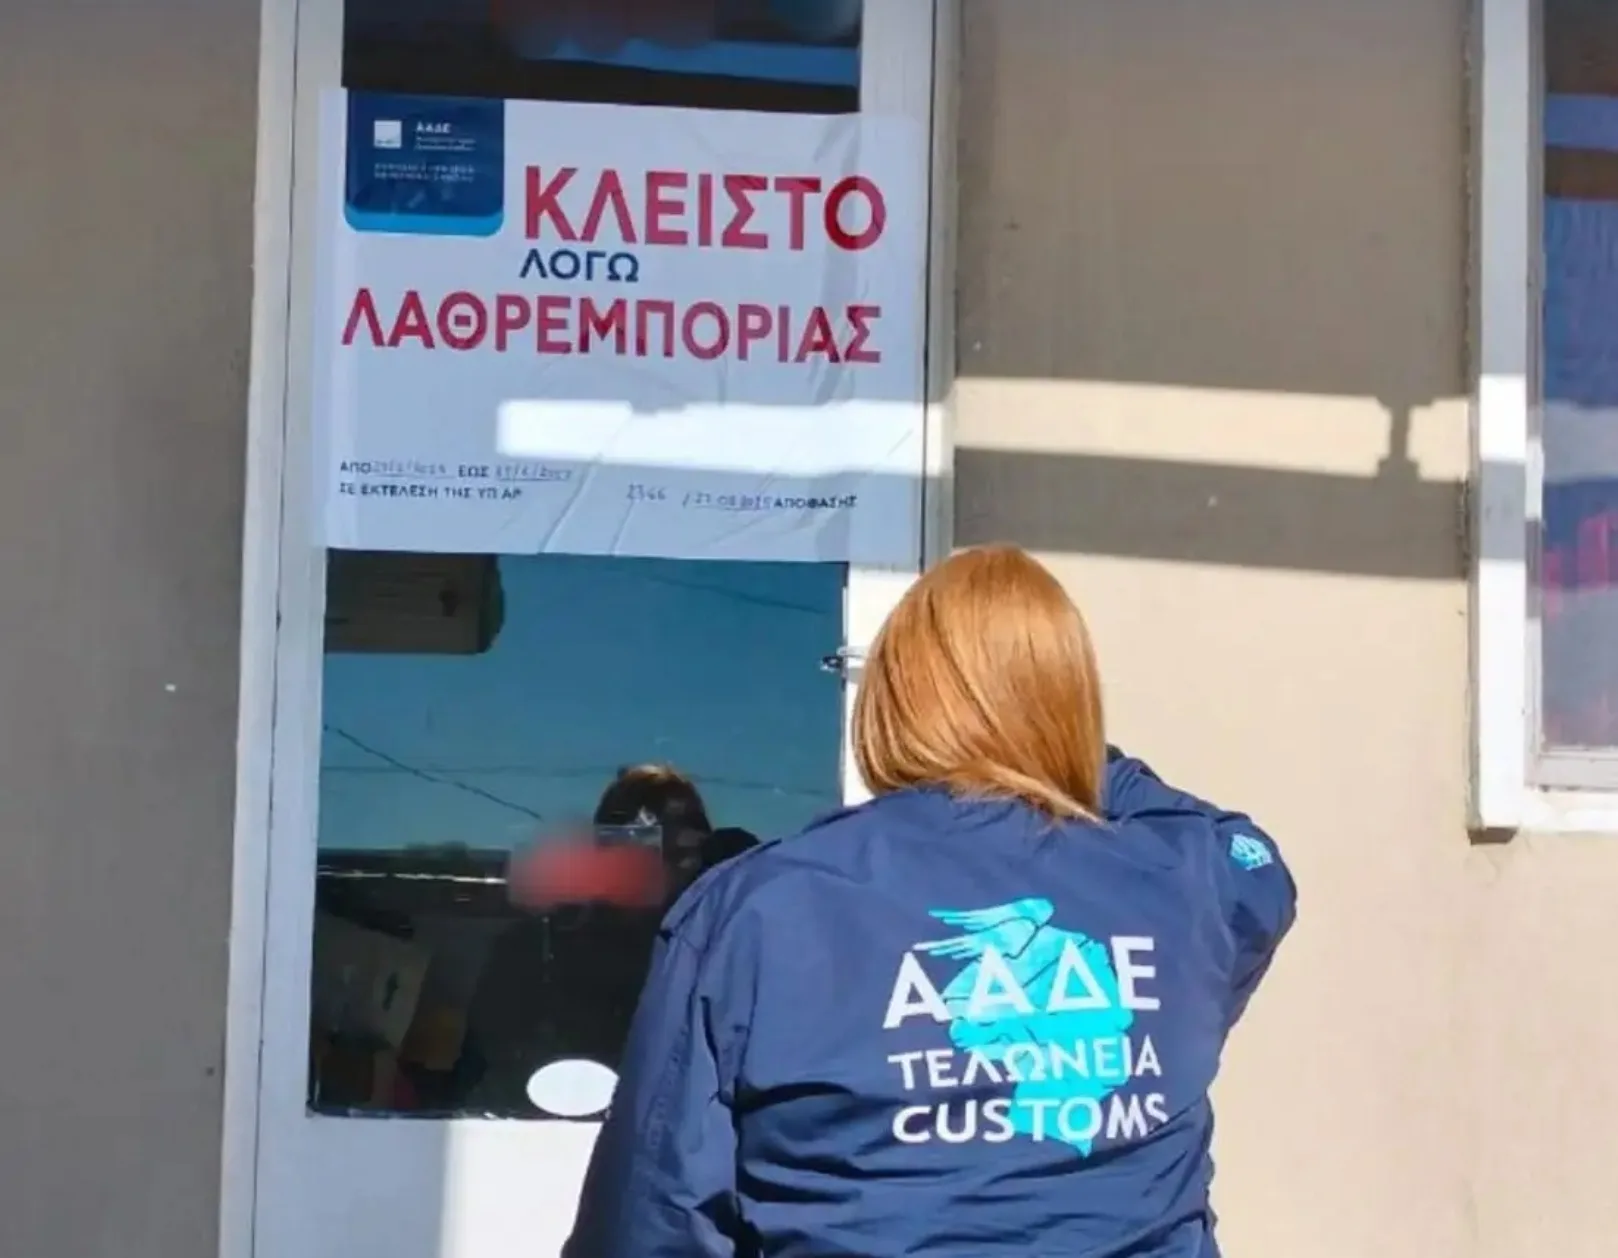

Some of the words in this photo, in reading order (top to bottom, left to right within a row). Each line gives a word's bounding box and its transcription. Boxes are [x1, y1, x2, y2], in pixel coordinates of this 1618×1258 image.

[524, 166, 887, 251] ΚΛΕΙΣΤΟ
[519, 249, 640, 283] ΛΟΓΩ
[341, 288, 882, 364] ΛΑΘΡΕΜΠΟΡΙΑΣ
[340, 461, 371, 474] ΑΠΟ
[458, 464, 489, 478] ΕΩΣ
[360, 484, 438, 498] ΕΚΤΕΛΕΣΗ
[773, 495, 858, 510] ΑΠΟΦΑΣΗΣ
[883, 936, 1161, 1029] ΑΑΔΕ
[888, 1034, 1163, 1090] ΤΕΛΩΝΕΙΑ
[892, 1093, 1169, 1143] CUSTOMS
